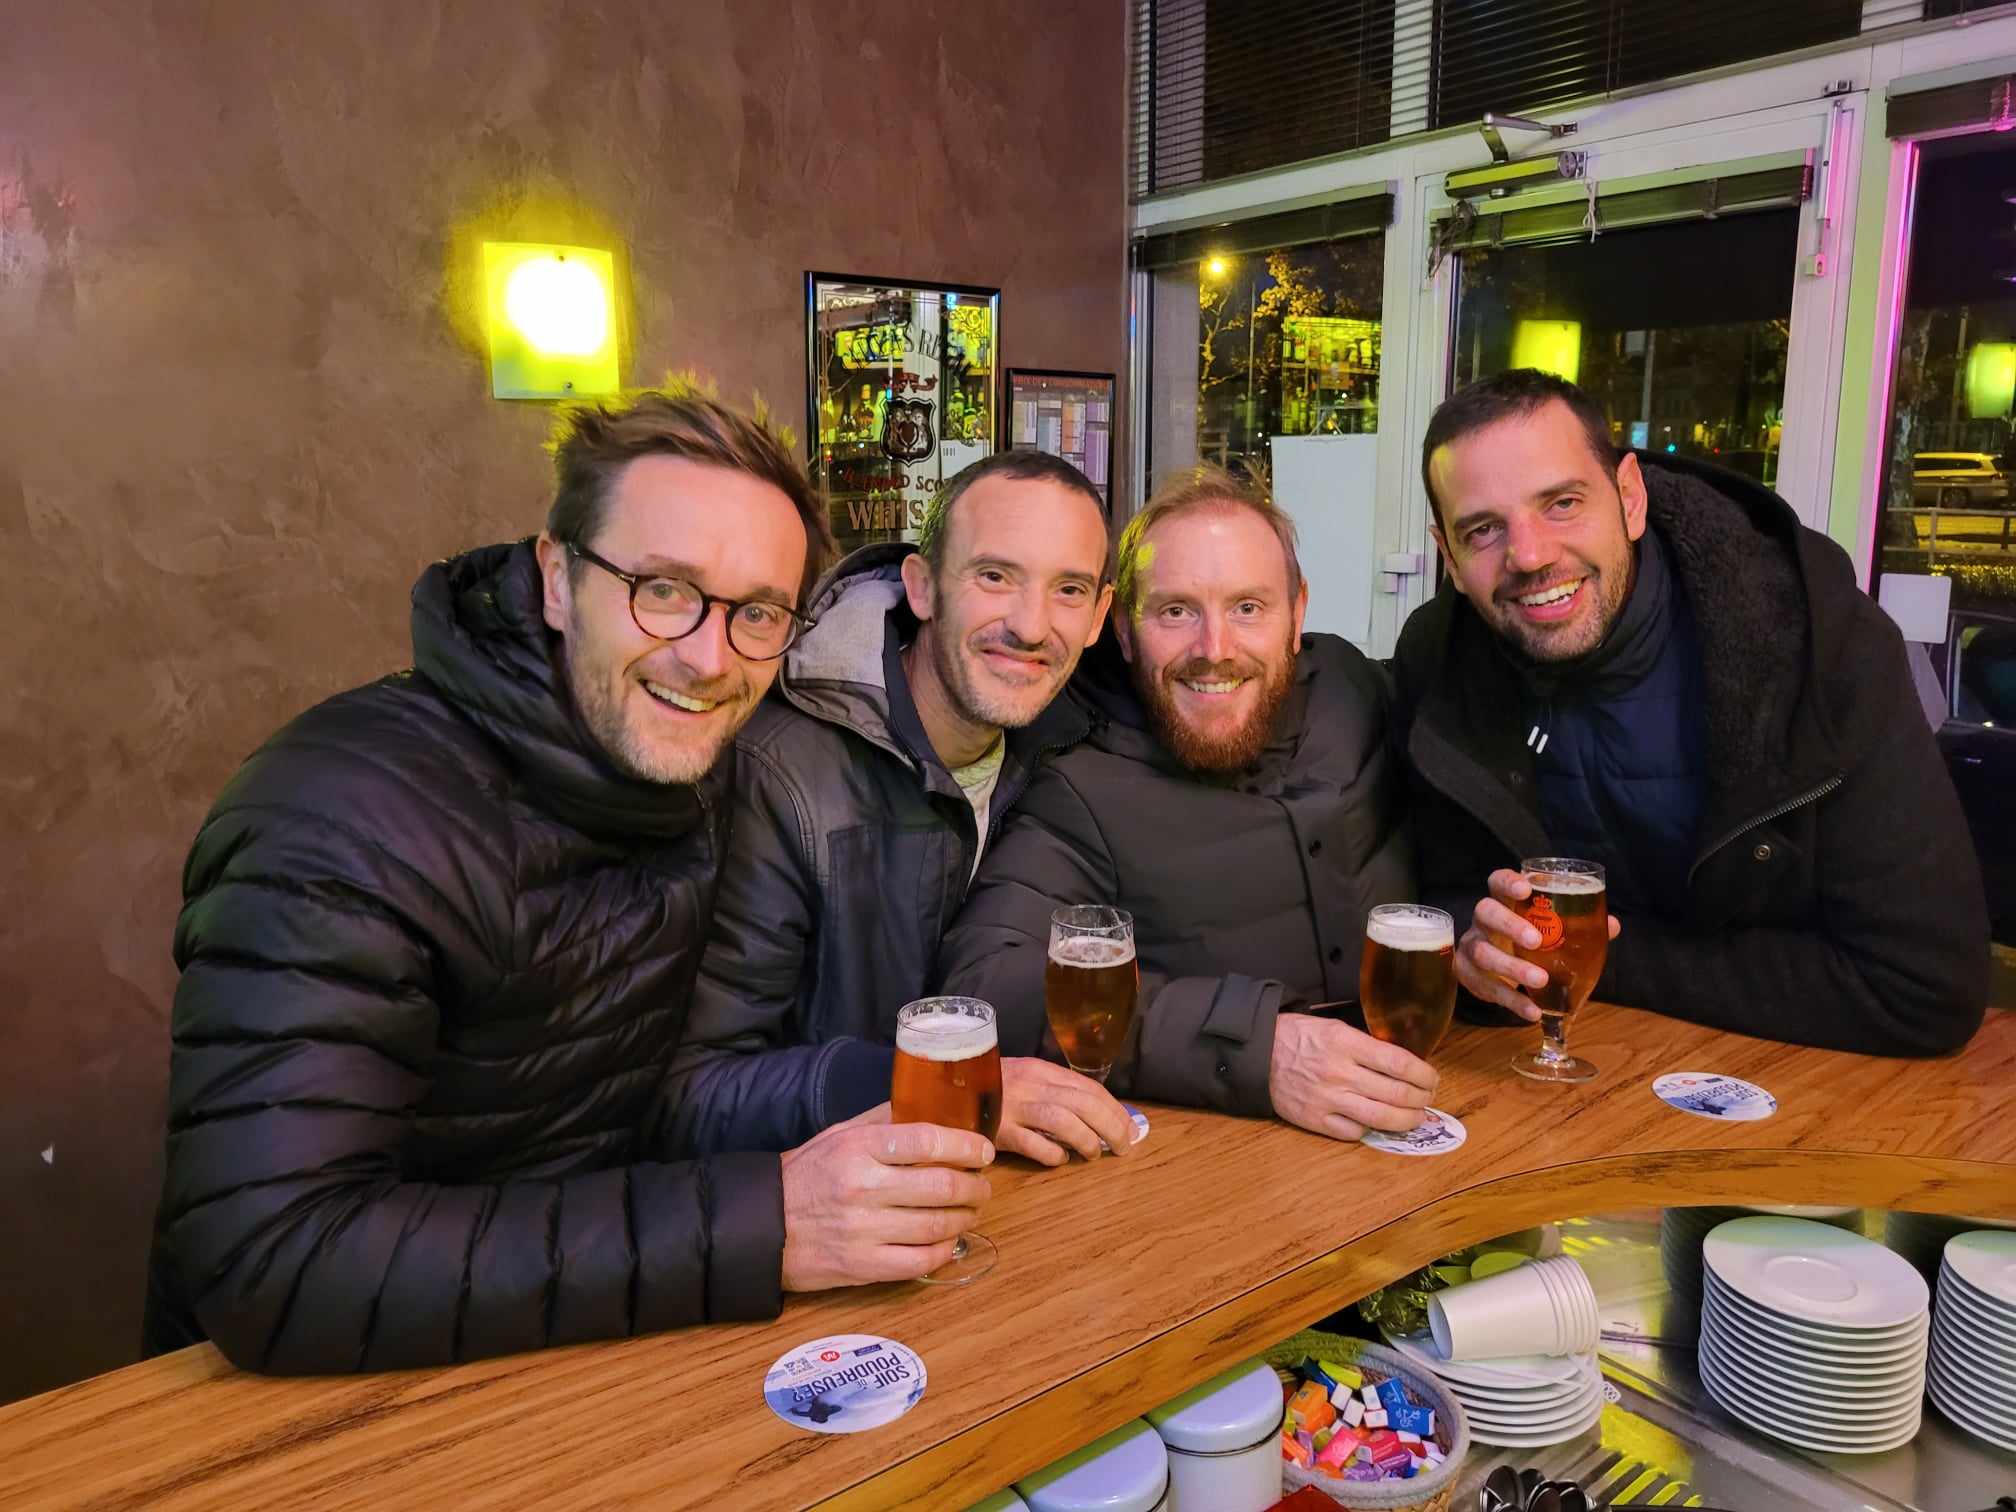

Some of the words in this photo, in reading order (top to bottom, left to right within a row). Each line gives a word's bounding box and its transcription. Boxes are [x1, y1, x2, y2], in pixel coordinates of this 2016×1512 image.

[847, 500, 926, 531] WHIS
[793, 1352, 901, 1403] POUDREUSE?
[856, 1379, 868, 1389] DE
[875, 1364, 911, 1389] SOIF
